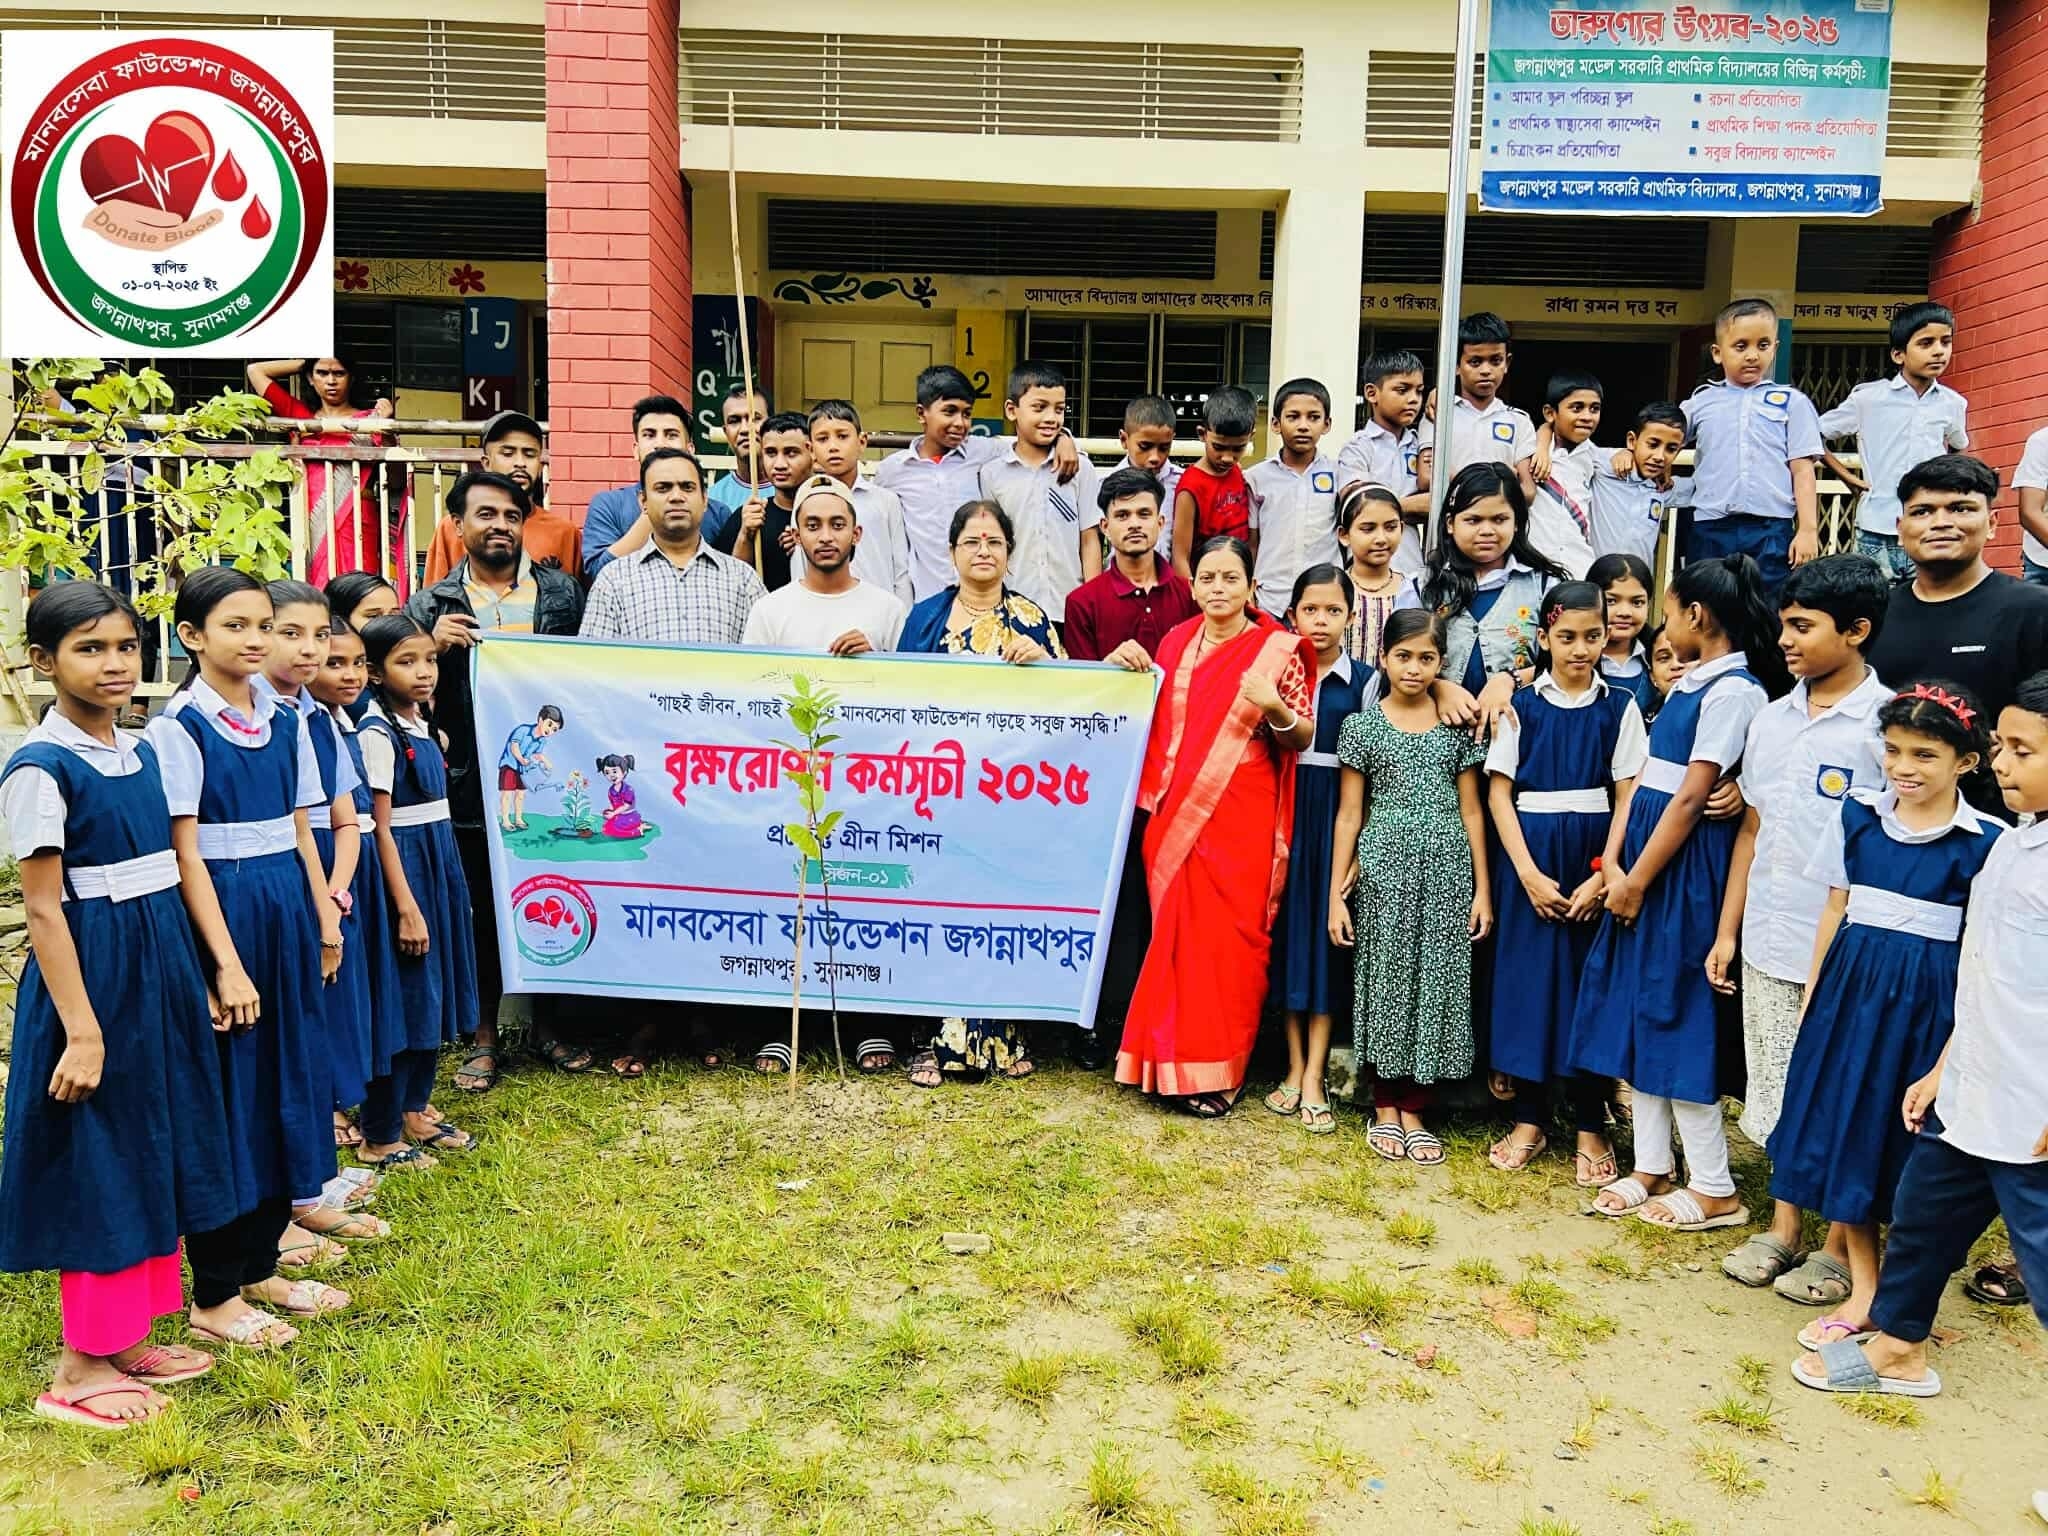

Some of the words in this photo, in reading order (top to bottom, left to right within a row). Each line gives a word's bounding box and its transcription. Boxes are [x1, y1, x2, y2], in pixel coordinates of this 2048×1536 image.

[1550, 8, 1665, 44] তারুণ্যের
[1673, 5, 1840, 46] উৎসব-২০২৫
[1513, 57, 1575, 79] জগন্নাথপুর
[1579, 58, 1614, 77] মডেল
[1618, 55, 1664, 77] সরকারি
[1666, 55, 1714, 78] প্রাথমিক
[1718, 56, 1780, 79] বিদ্যালয়ের
[1783, 58, 1818, 81] বিভিন্ন
[1509, 91, 1543, 105] আমার
[1570, 88, 1610, 106] পরিচ্ছন্ন
[1708, 93, 1735, 107] রচনা
[1738, 90, 1802, 108] প্রতিযোগিতা
[1508, 115, 1551, 131] প্রাথমিক
[1607, 115, 1660, 132] ক্যাম্পেইন
[1706, 116, 1749, 133] প্রাথমিক
[1753, 117, 1780, 133] শিক্ষা
[1816, 118, 1878, 136] প্রতিযোগিতা
[1507, 140, 1553, 158] চিত্রাংকন
[1558, 140, 1621, 158] প্রতিযোগিতা
[1704, 146, 1732, 163] সবুজ
[1736, 143, 1780, 161] বিদ্যালয়
[1783, 145, 1836, 161] ক্যাম্পেইন
[1499, 180, 1556, 200] জগন্নাথপুর
[1561, 180, 1594, 196] মডেল
[1598, 176, 1640, 196] সরকারি
[1643, 177, 1687, 197] প্রাথমিক
[1025, 288, 1084, 306] আমাদের
[1088, 287, 1138, 305] বিদ্যালয়
[1142, 291, 1197, 308] আমাদের
[1545, 296, 1580, 313] রাধা
[1583, 298, 1619, 314] রমন
[1625, 300, 1650, 316] দত্ত
[1654, 300, 1679, 317] হল
[470, 306, 479, 335] I
[1846, 304, 1878, 321] মানুষ
[494, 320, 510, 350] J
[965, 326, 975, 356] 1
[469, 378, 487, 406] K
[697, 369, 718, 397] Q
[972, 371, 992, 399] 2
[698, 409, 717, 440] S
[747, 698, 783, 719] গাছই
[840, 705, 905, 725] মানবসেবা
[911, 704, 979, 729] ফাউন্ডেশন
[986, 712, 1026, 733] গড়ছে
[1030, 714, 1065, 736] সবুজ
[845, 738, 967, 821] কর্মসূচী
[977, 757, 1090, 807] ২০২৫
[840, 820, 881, 852] গ্রীন
[886, 824, 944, 855] মিশন
[621, 902, 768, 946] মানবসেবা
[776, 904, 933, 957] ফাউন্ডেশন
[941, 921, 1096, 972] জগন্নাথপুর
